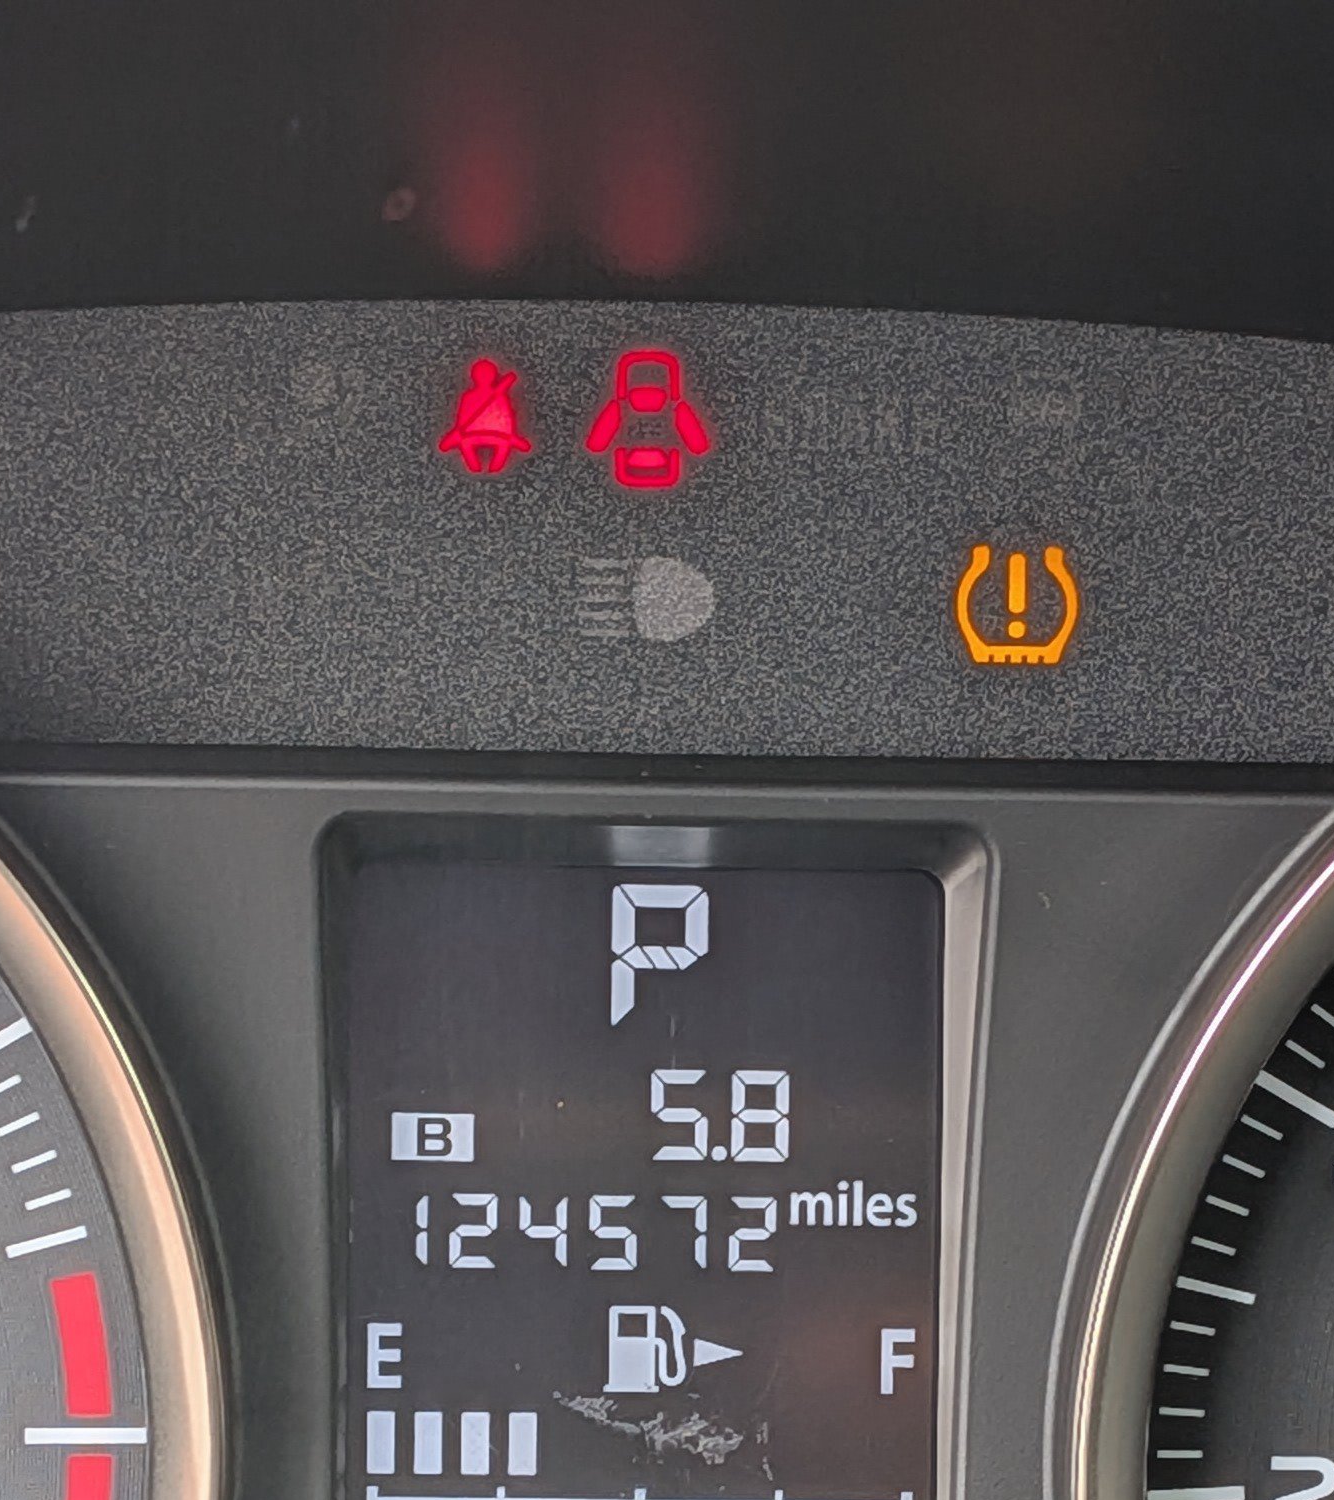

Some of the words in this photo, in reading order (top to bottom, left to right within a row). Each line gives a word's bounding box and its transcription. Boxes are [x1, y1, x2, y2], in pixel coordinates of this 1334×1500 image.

[611, 884, 709, 1025] P
[416, 1117, 453, 1157] B
[651, 1070, 789, 1162] 5.8
[416, 1193, 777, 1271] 124572
[790, 1181, 917, 1226] miles
[367, 1323, 402, 1388] E
[881, 1329, 915, 1394] F
